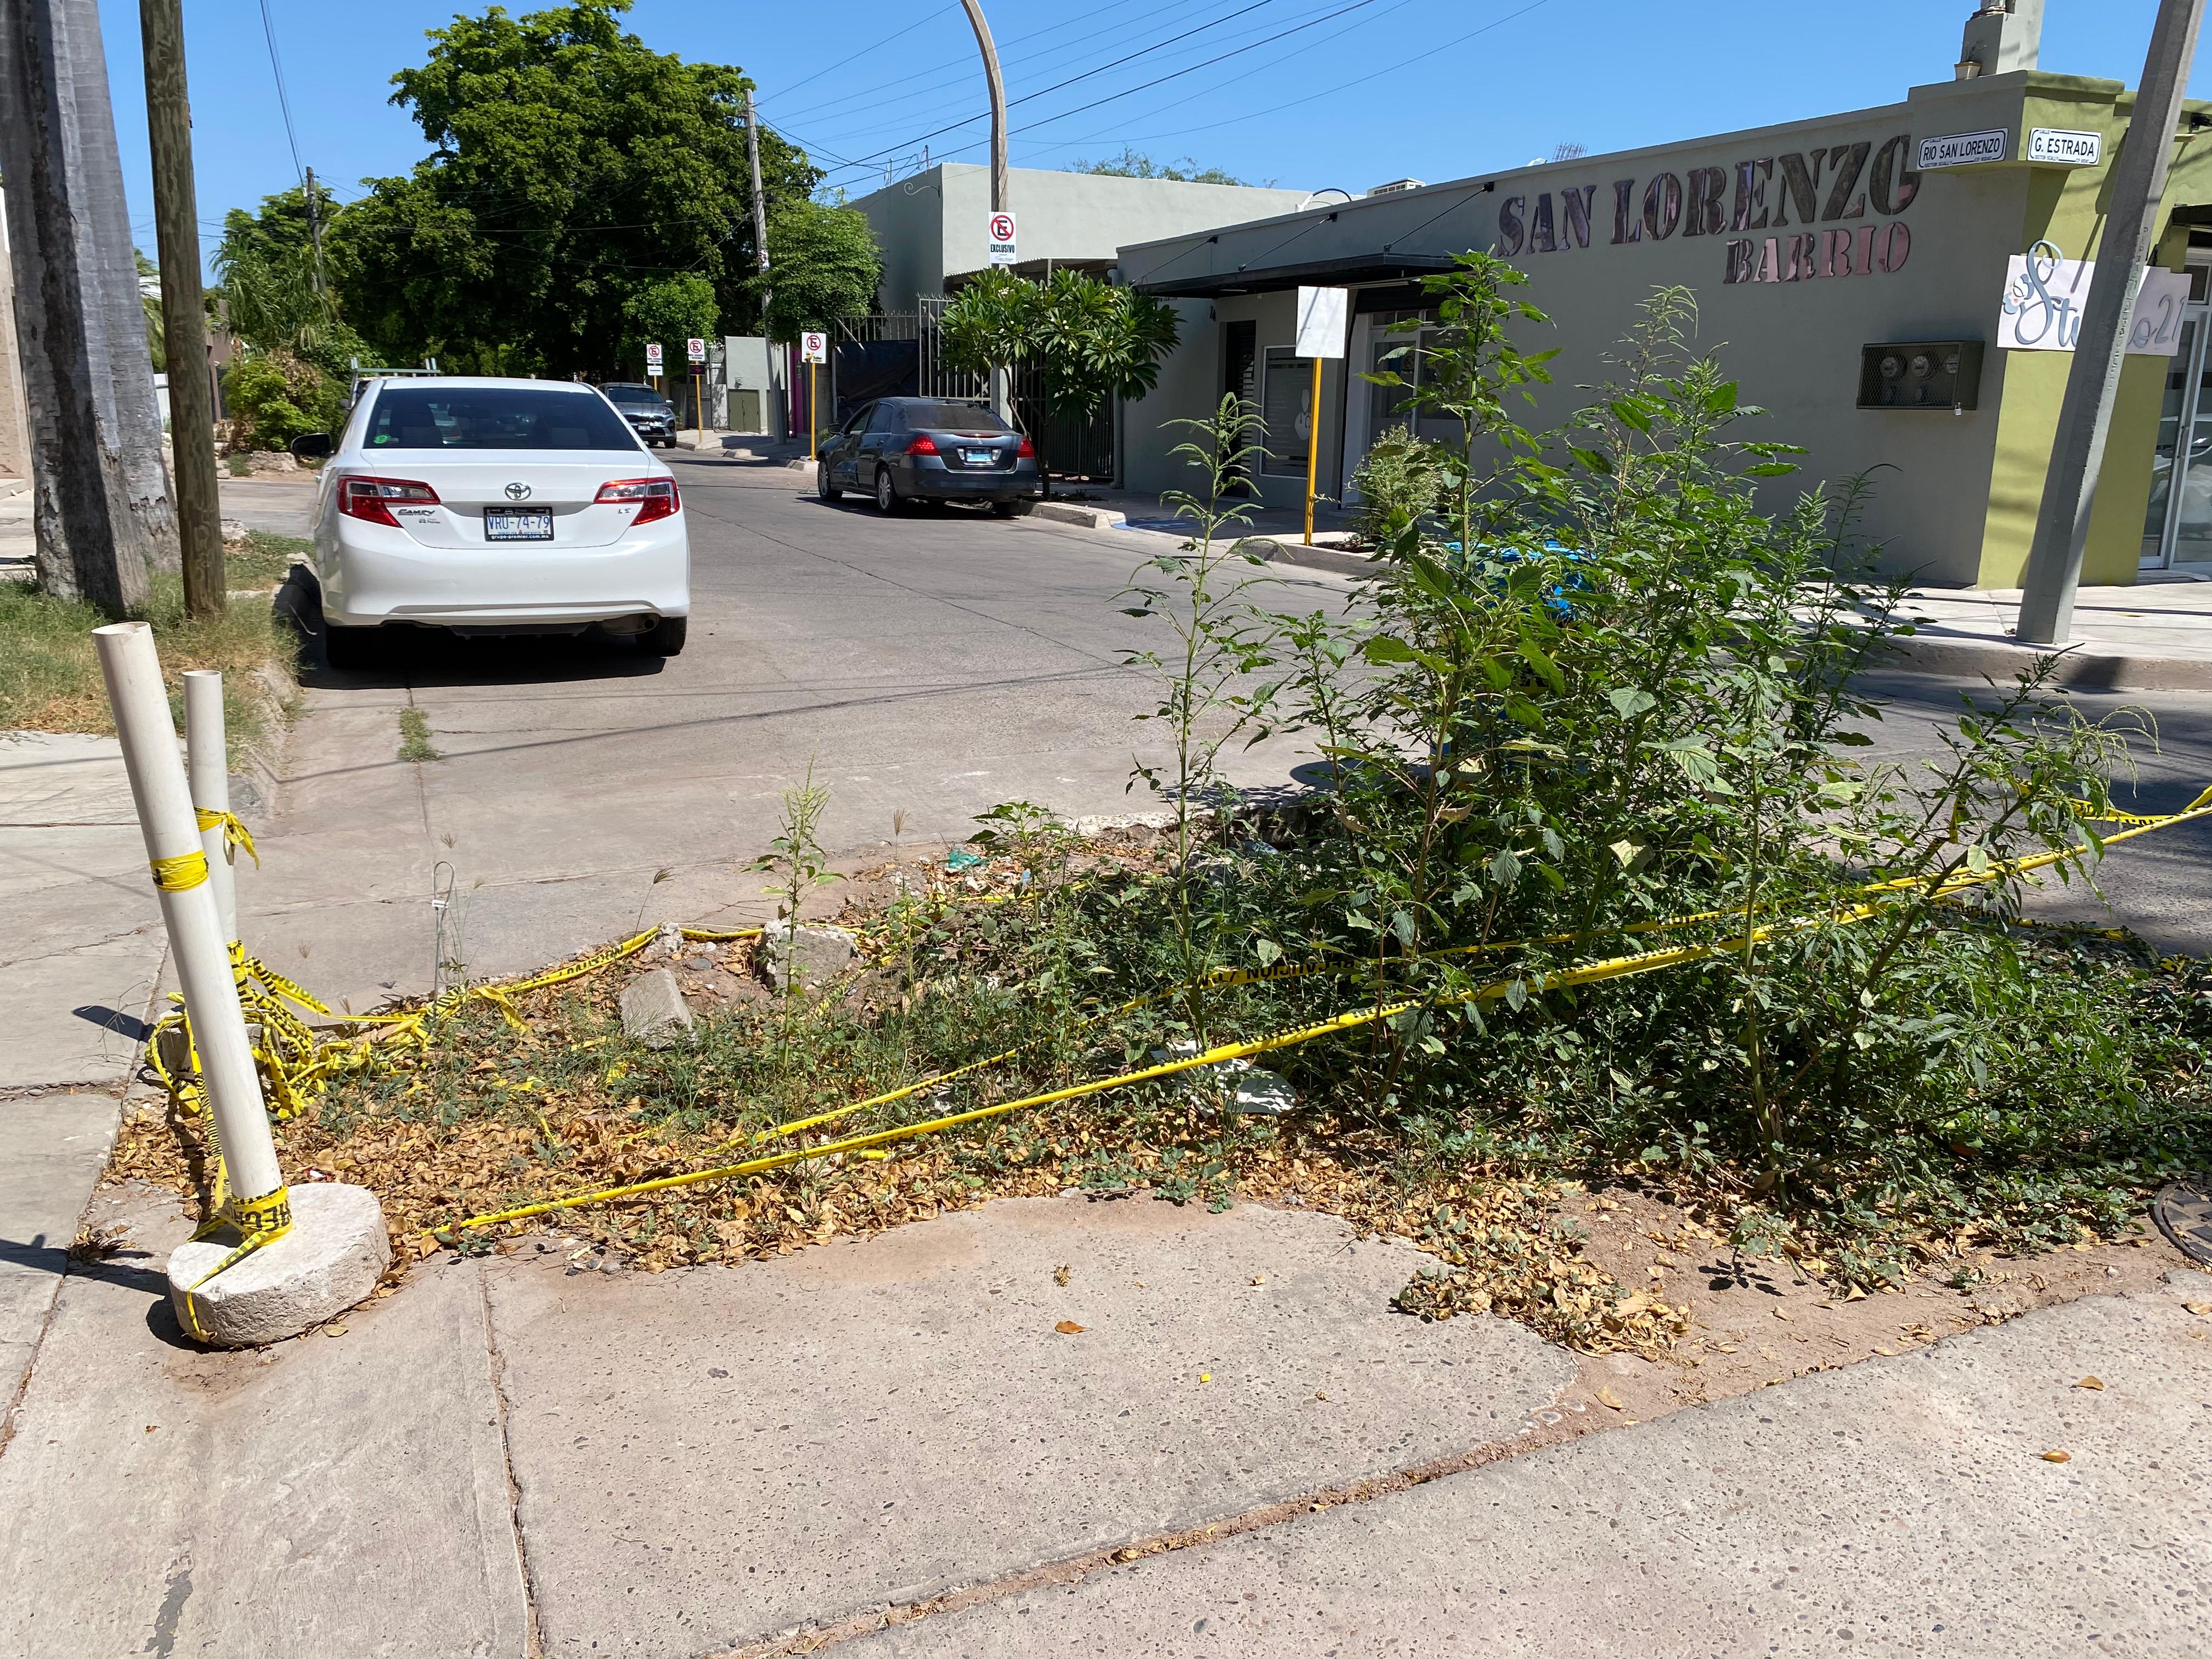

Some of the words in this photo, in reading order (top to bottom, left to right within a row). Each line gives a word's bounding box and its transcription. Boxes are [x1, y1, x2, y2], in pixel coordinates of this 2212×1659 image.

[1923, 146, 1937, 161] RIO
[1939, 143, 1958, 159] SAN
[1960, 138, 2000, 157] LORENZO
[2035, 137, 2044, 153] G.
[2047, 138, 2094, 157] ESTRADA
[1497, 184, 1597, 257] SAN
[1610, 134, 1920, 245] LORENZO
[990, 244, 1015, 253] EXCLUSIVO
[1723, 222, 1911, 284] BARRIO
[488, 515, 550, 529] VRU-74-79
